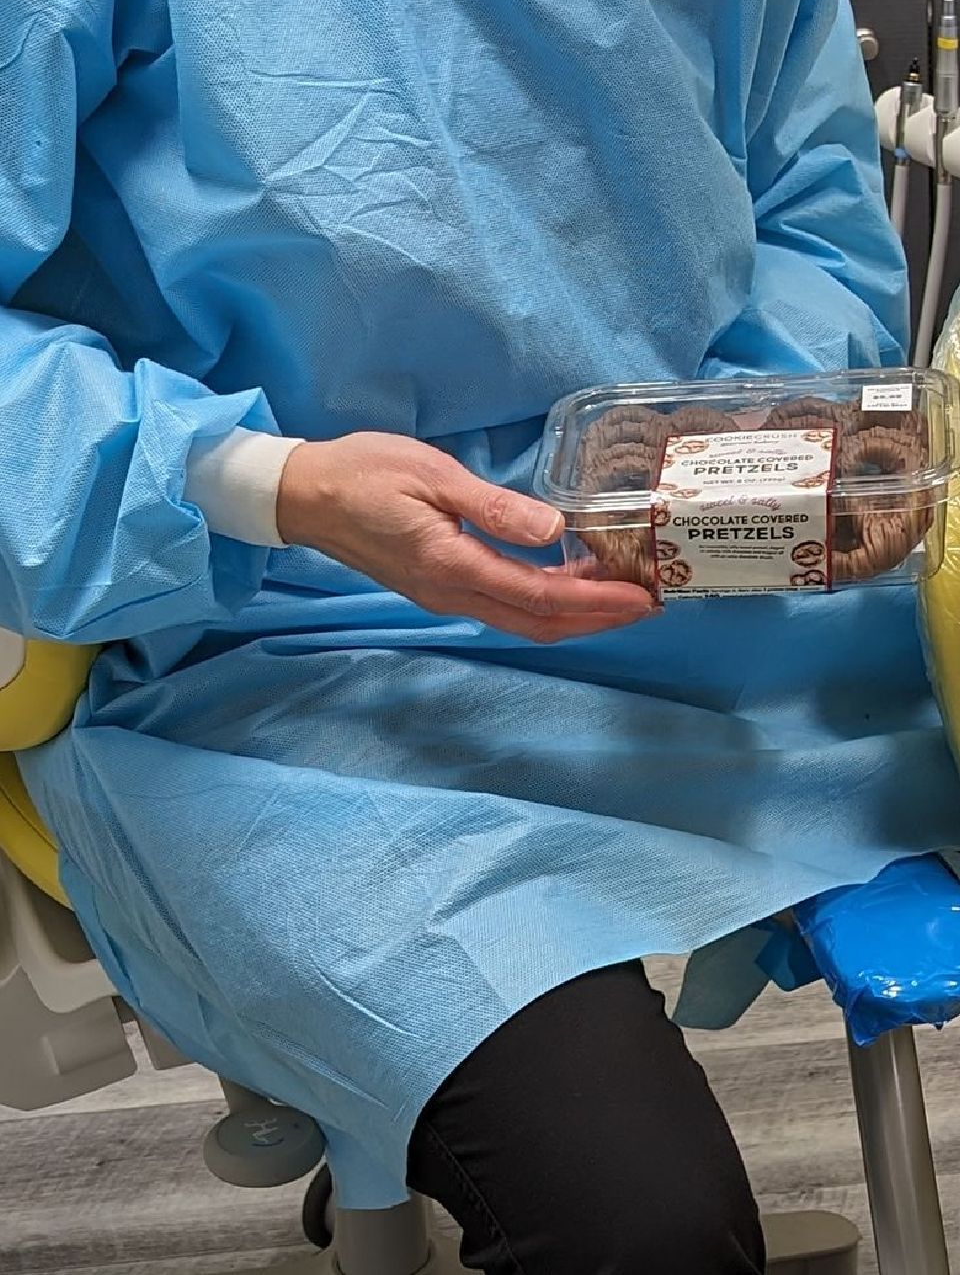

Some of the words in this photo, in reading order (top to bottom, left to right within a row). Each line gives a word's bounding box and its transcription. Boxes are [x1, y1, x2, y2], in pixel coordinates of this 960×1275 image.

[681, 457, 751, 466] CHOCOLATE
[756, 454, 814, 464] COVERED
[693, 462, 799, 475] PRETZELS
[673, 515, 748, 526] CHOCOLATE
[751, 514, 809, 525] COVERED
[688, 526, 795, 540] PRETZELS
